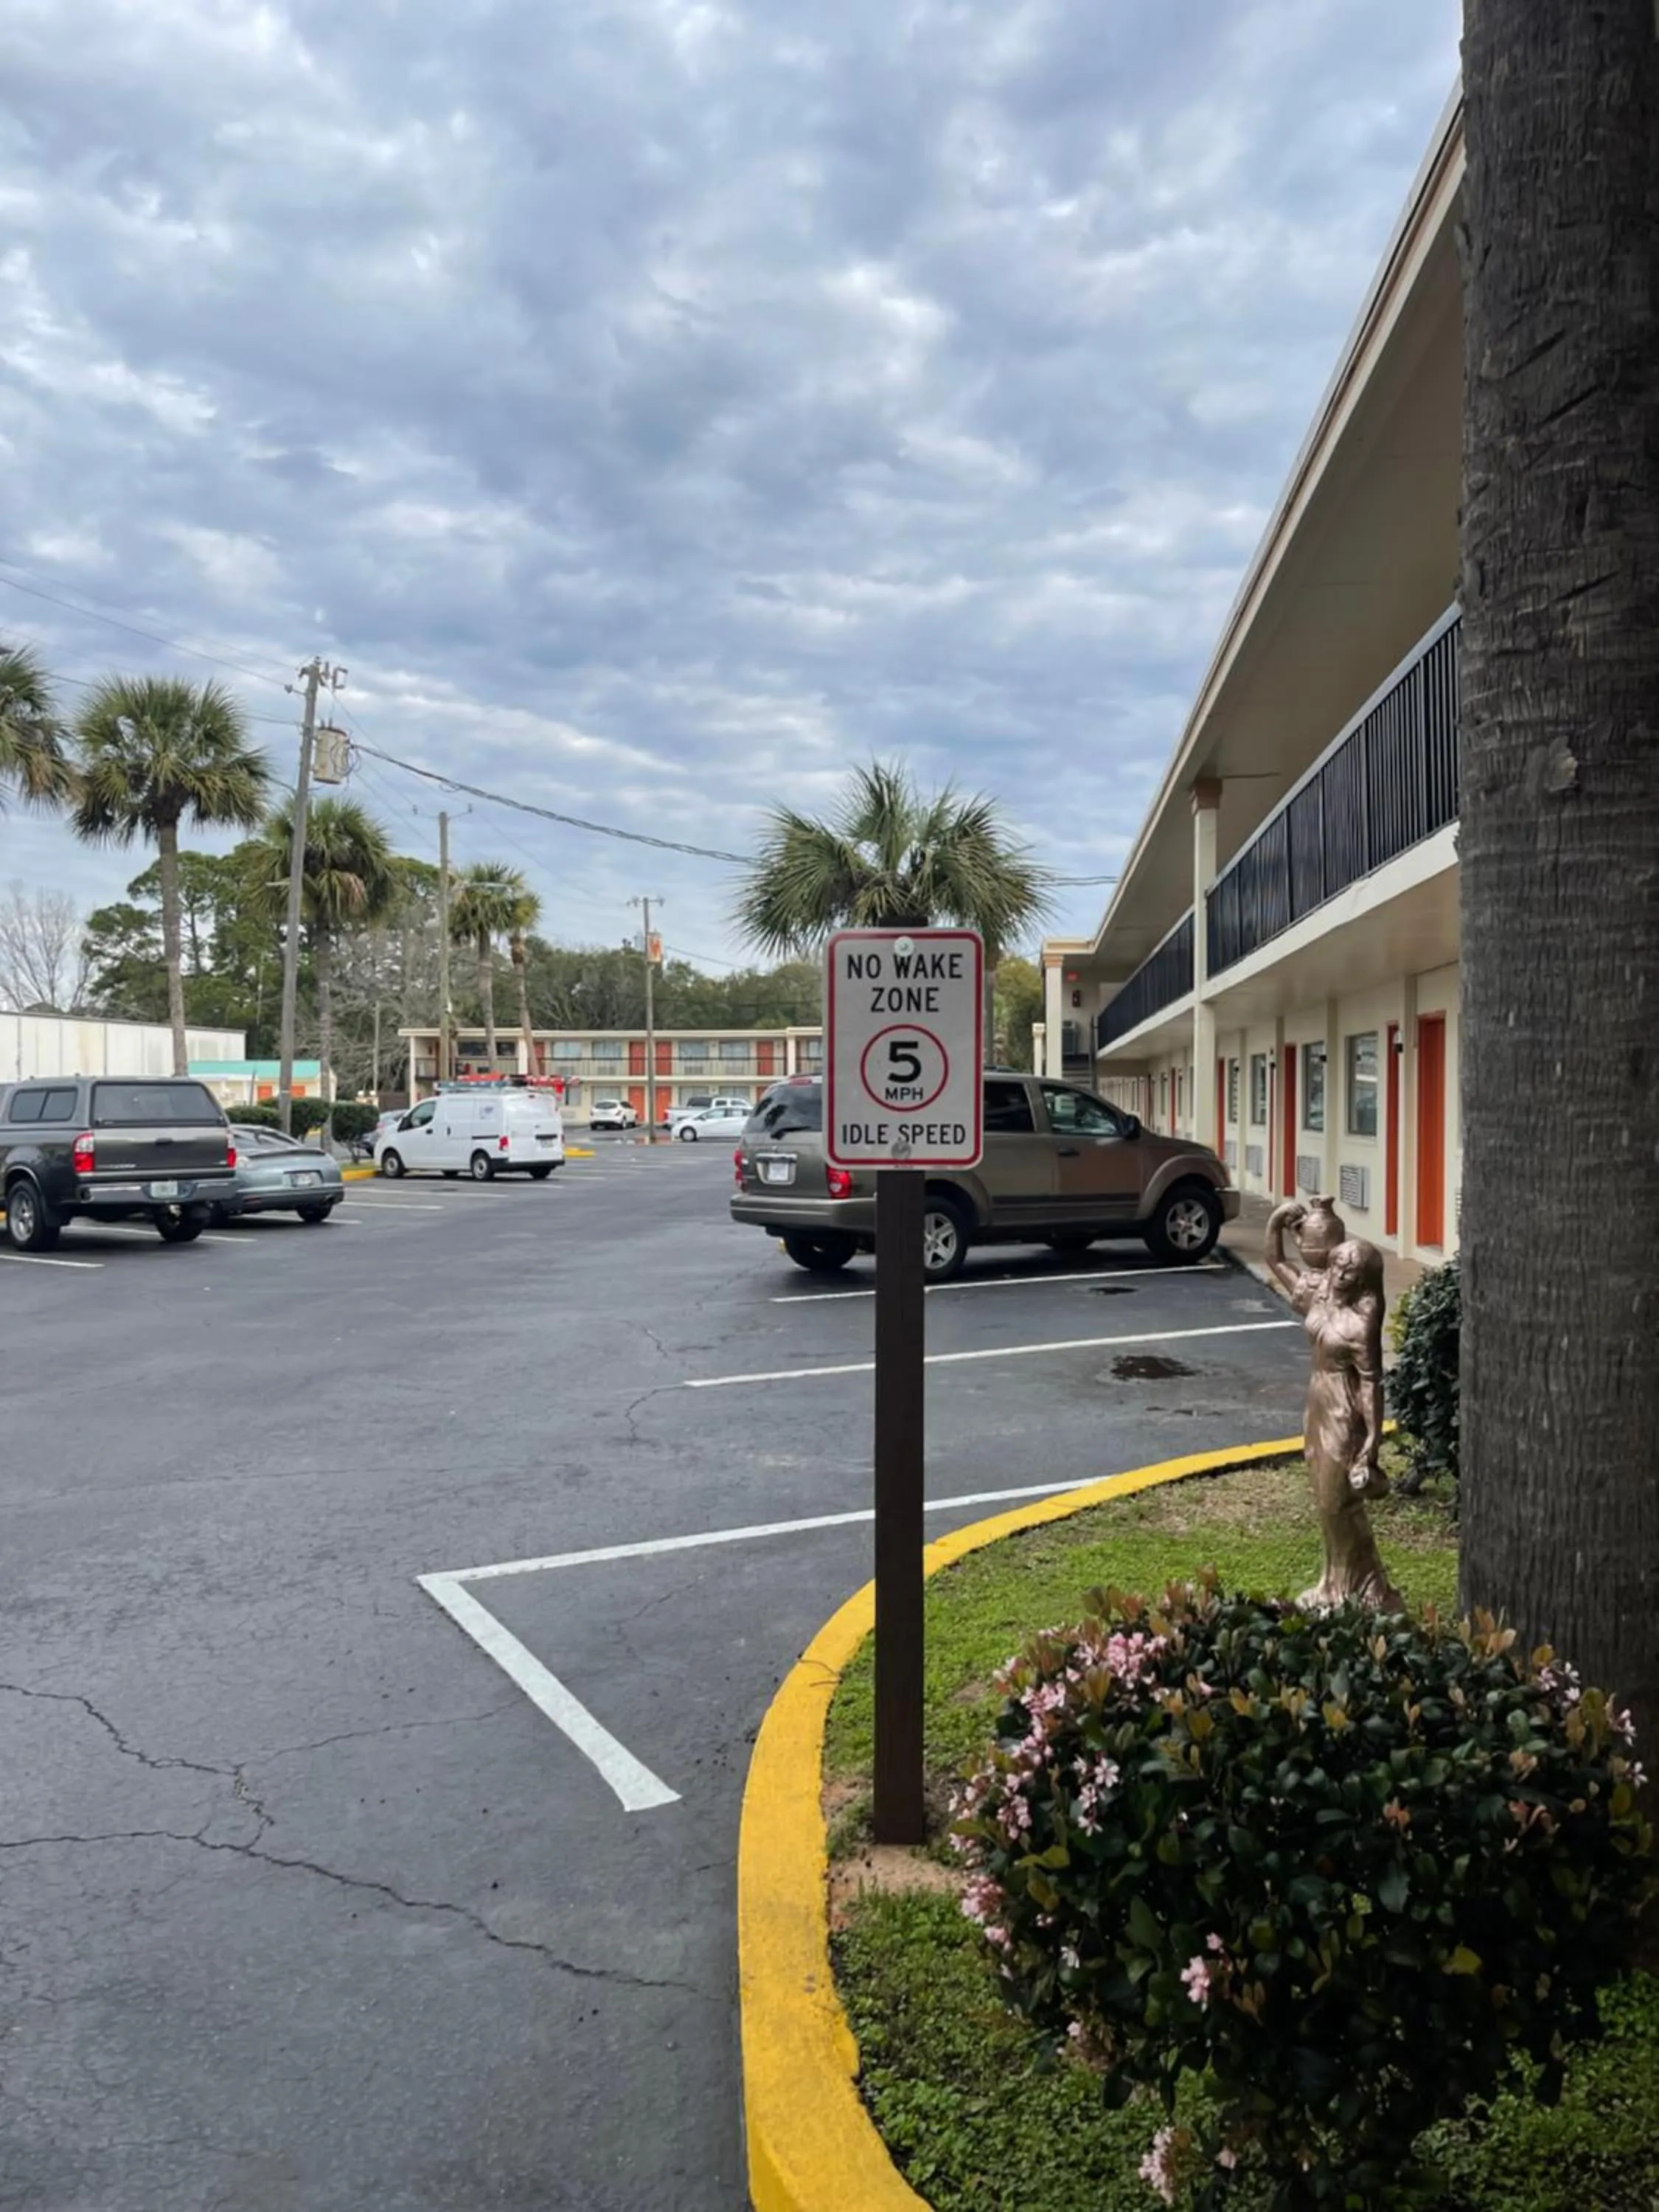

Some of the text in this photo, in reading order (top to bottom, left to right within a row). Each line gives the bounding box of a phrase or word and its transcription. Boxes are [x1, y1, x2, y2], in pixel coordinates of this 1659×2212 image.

[847, 953, 964, 980] NO WAKE
[870, 987, 940, 1013] ZONE
[887, 1040, 922, 1084] 5
[885, 1087, 924, 1101] MPH
[842, 1124, 889, 1145] IDLE
[897, 1124, 966, 1145] SPEED
